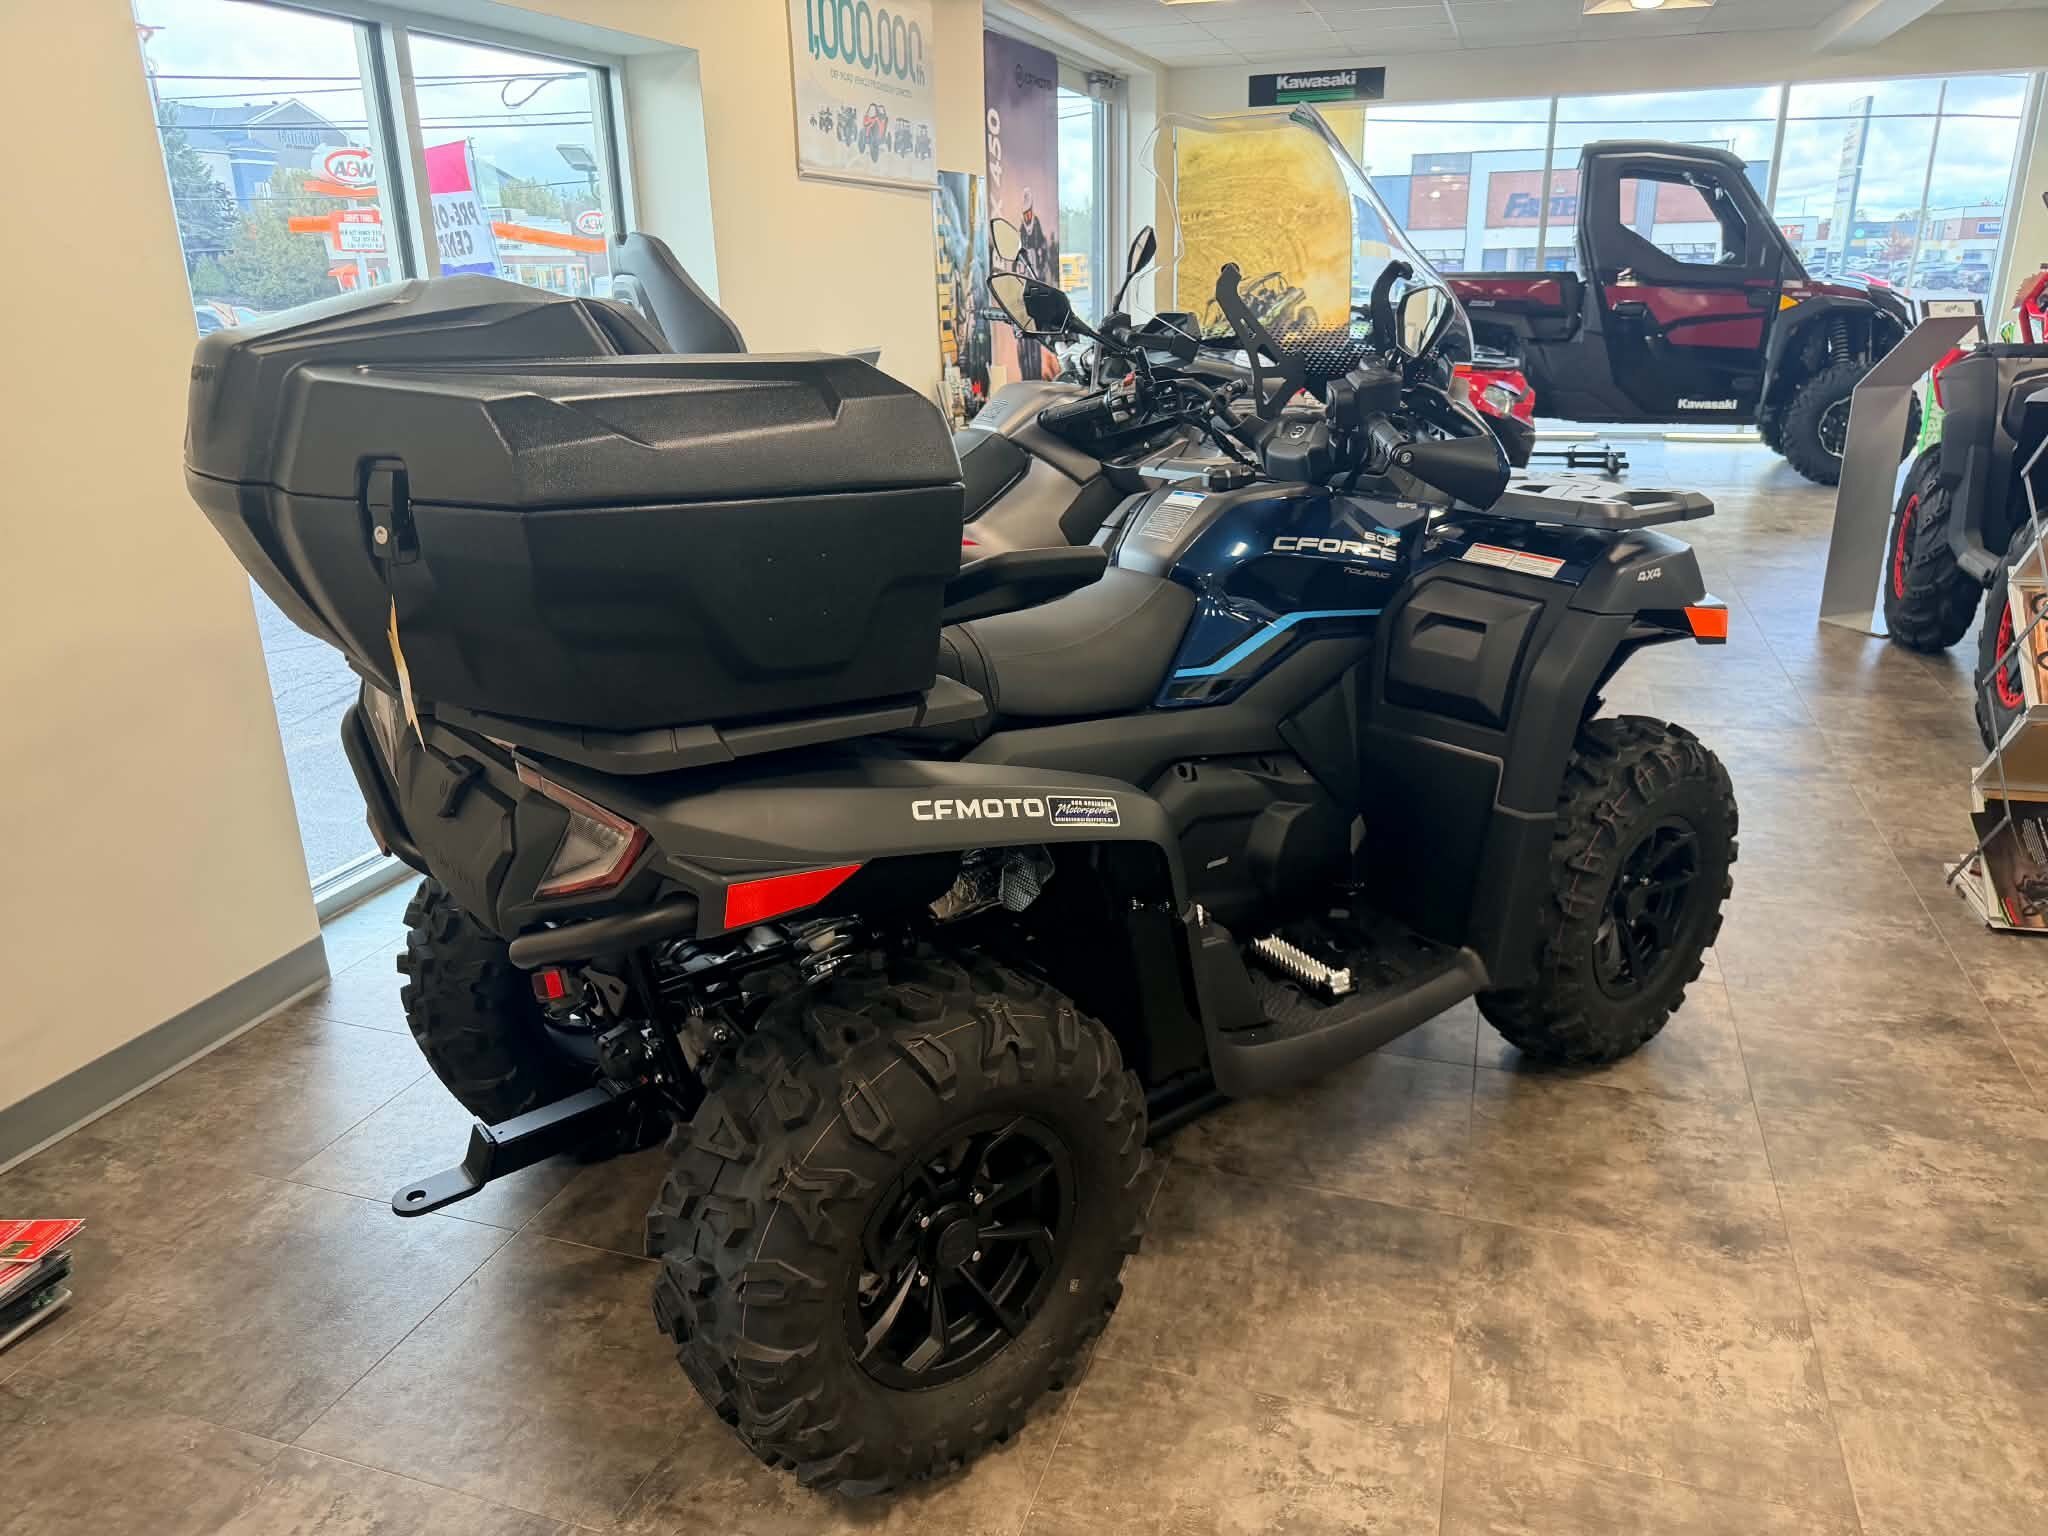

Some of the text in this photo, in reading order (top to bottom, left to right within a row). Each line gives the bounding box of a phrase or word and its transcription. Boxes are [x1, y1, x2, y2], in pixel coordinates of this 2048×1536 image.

[1277, 71, 1358, 89] Kawasaki
[987, 108, 1003, 187] 450
[334, 159, 374, 178] A&W
[1678, 399, 1738, 409] Kawasaki
[1273, 536, 1397, 561] CFORCE
[1343, 567, 1392, 579] TOURING
[911, 798, 1045, 821] CFMOTO
[1055, 803, 1114, 819] Motorsports
